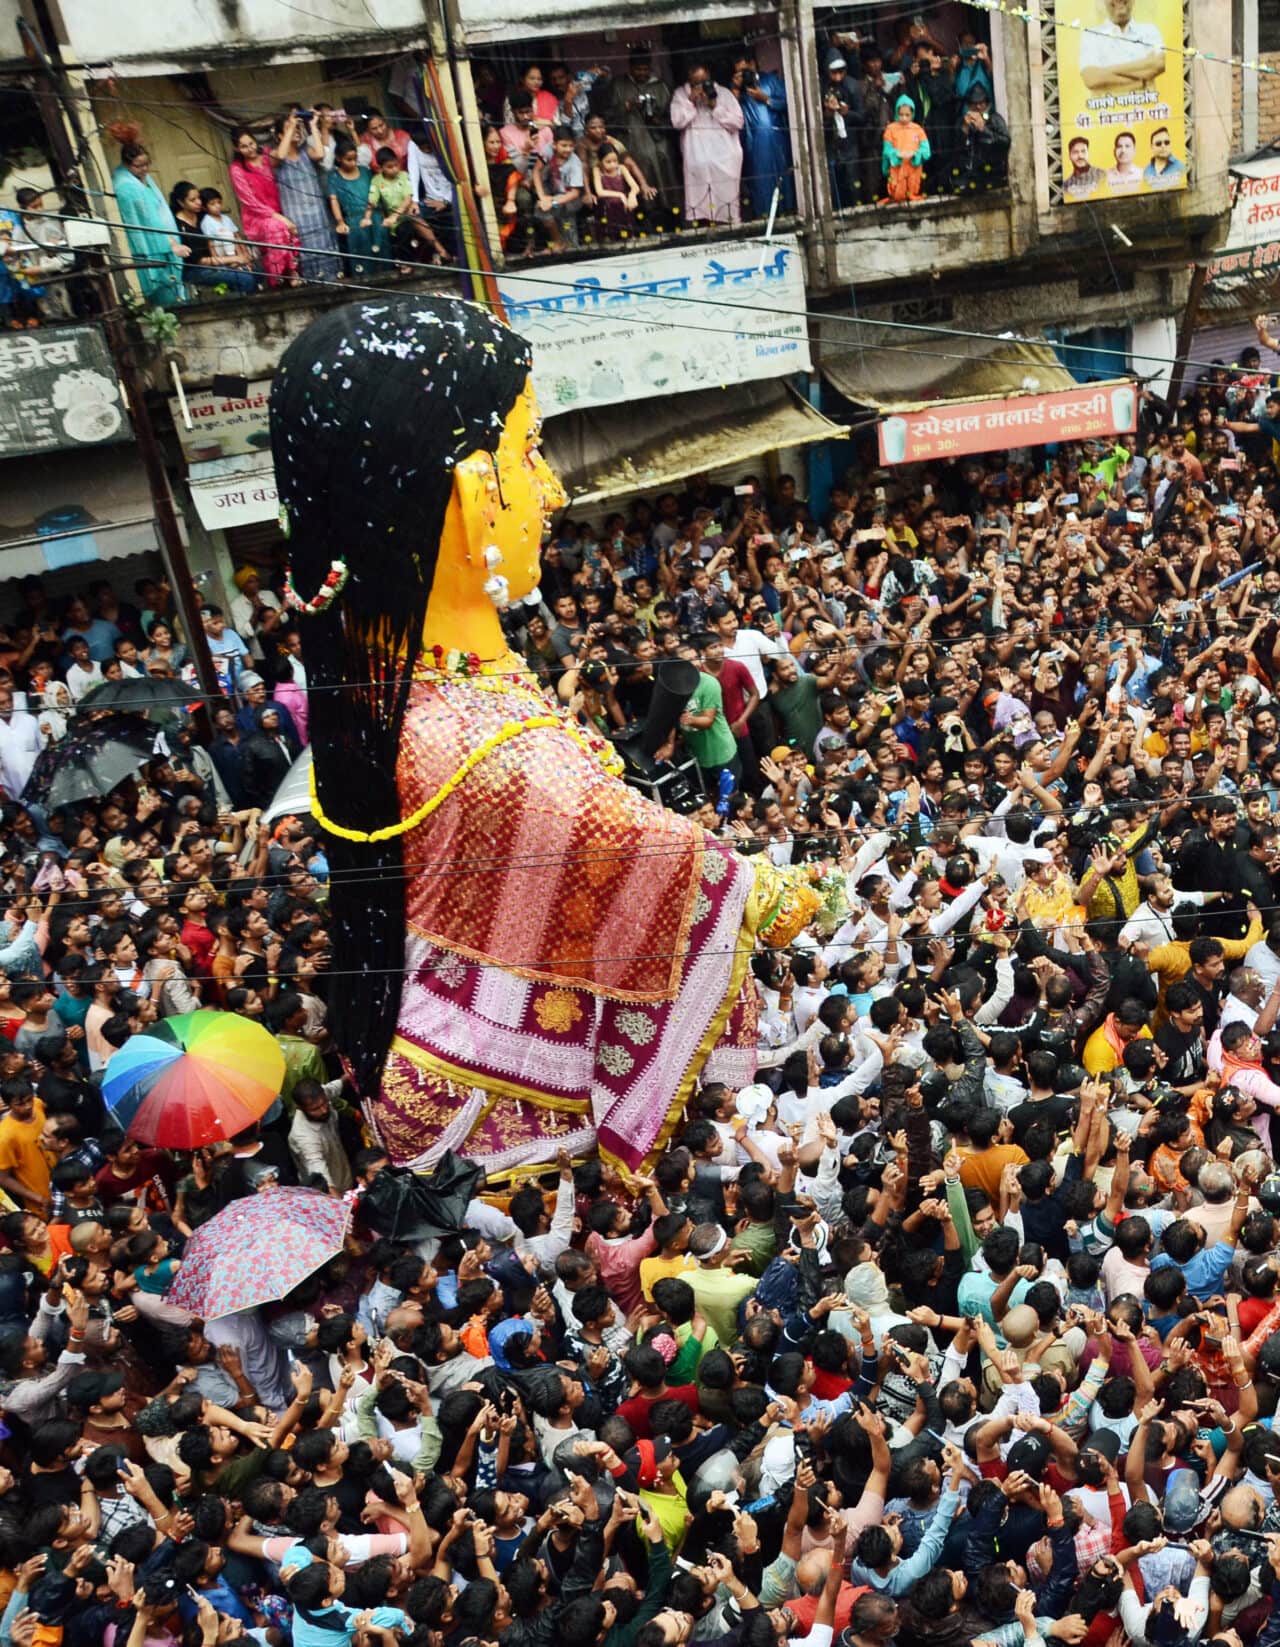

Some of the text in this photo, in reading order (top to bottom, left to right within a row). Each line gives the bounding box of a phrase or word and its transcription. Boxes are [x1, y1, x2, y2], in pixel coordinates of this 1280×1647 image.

[911, 393, 1108, 438] स्पेशल मलाई लस्सी
[214, 491, 247, 508] जय
